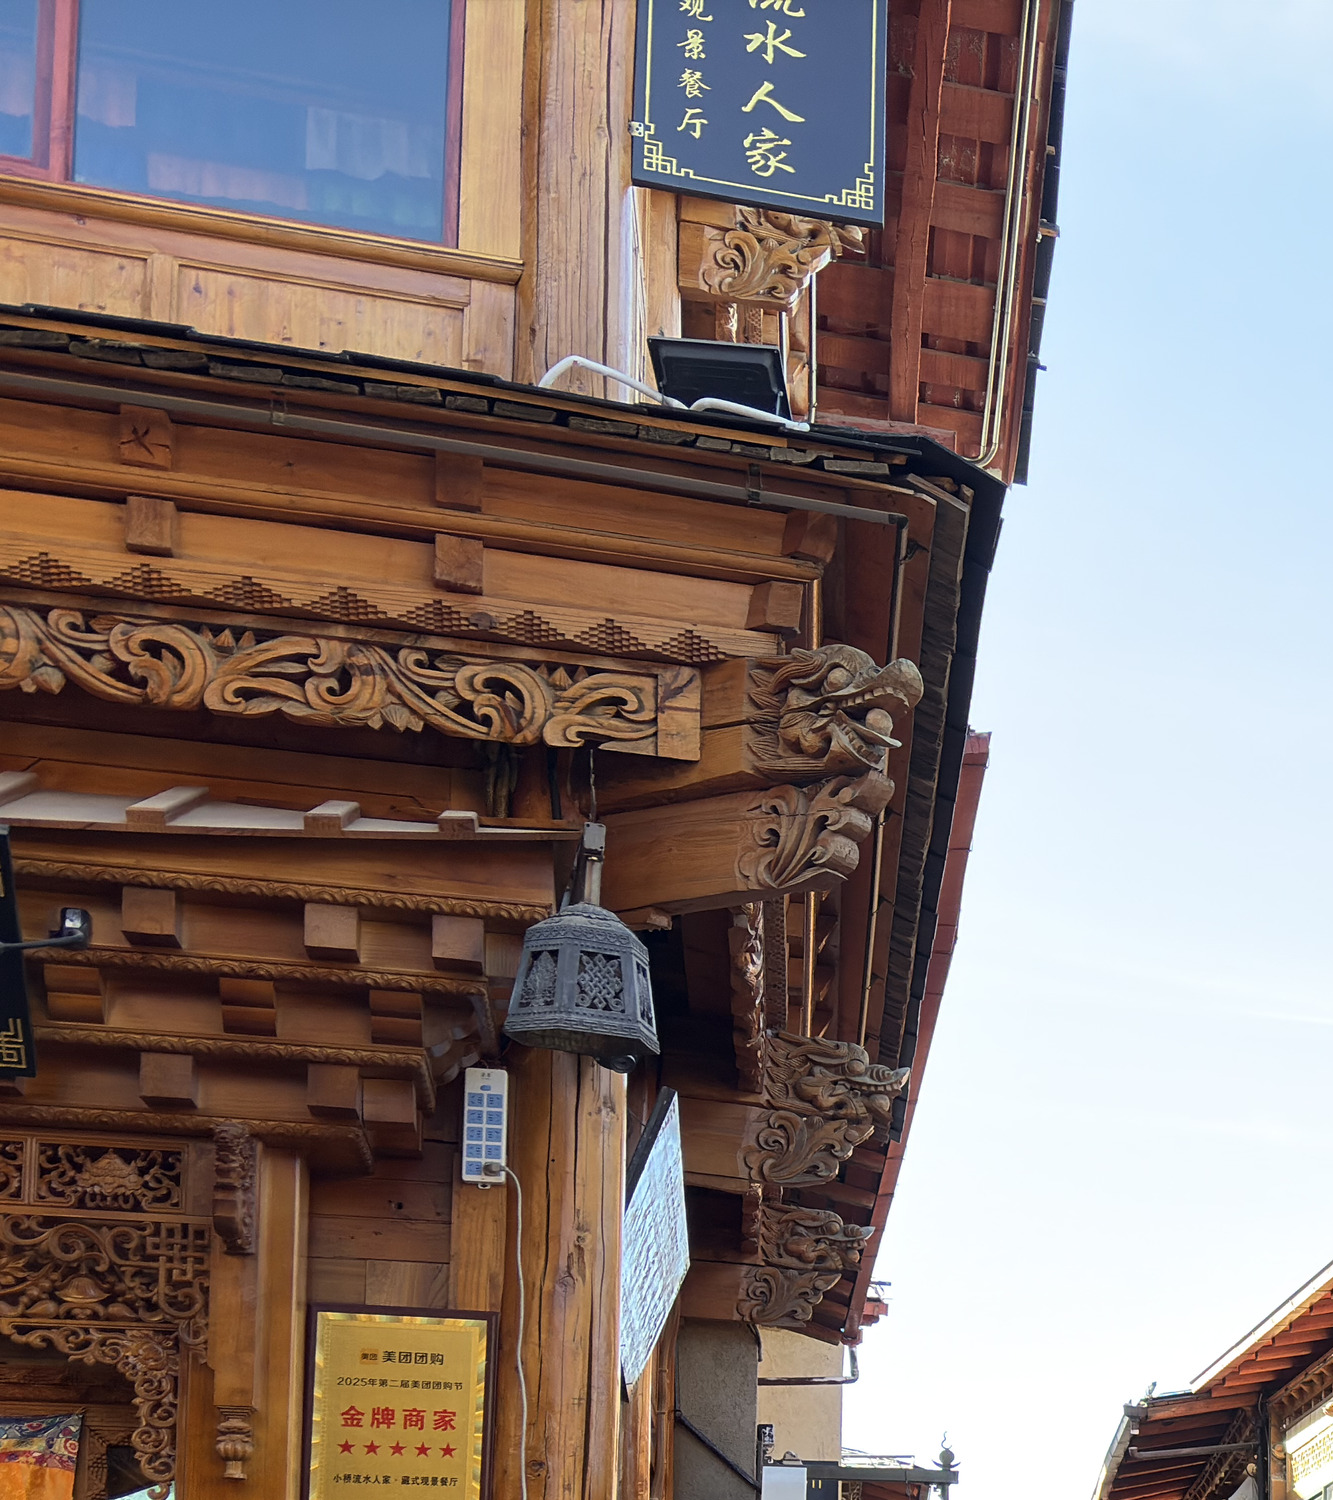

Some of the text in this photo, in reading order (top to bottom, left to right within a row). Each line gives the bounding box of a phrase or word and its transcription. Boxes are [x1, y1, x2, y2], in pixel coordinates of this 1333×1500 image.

[382, 1351, 444, 1366] 美团团购
[336, 1376, 463, 1391] 2025年第二届美团团购节
[340, 1405, 457, 1432] 金牌商家
